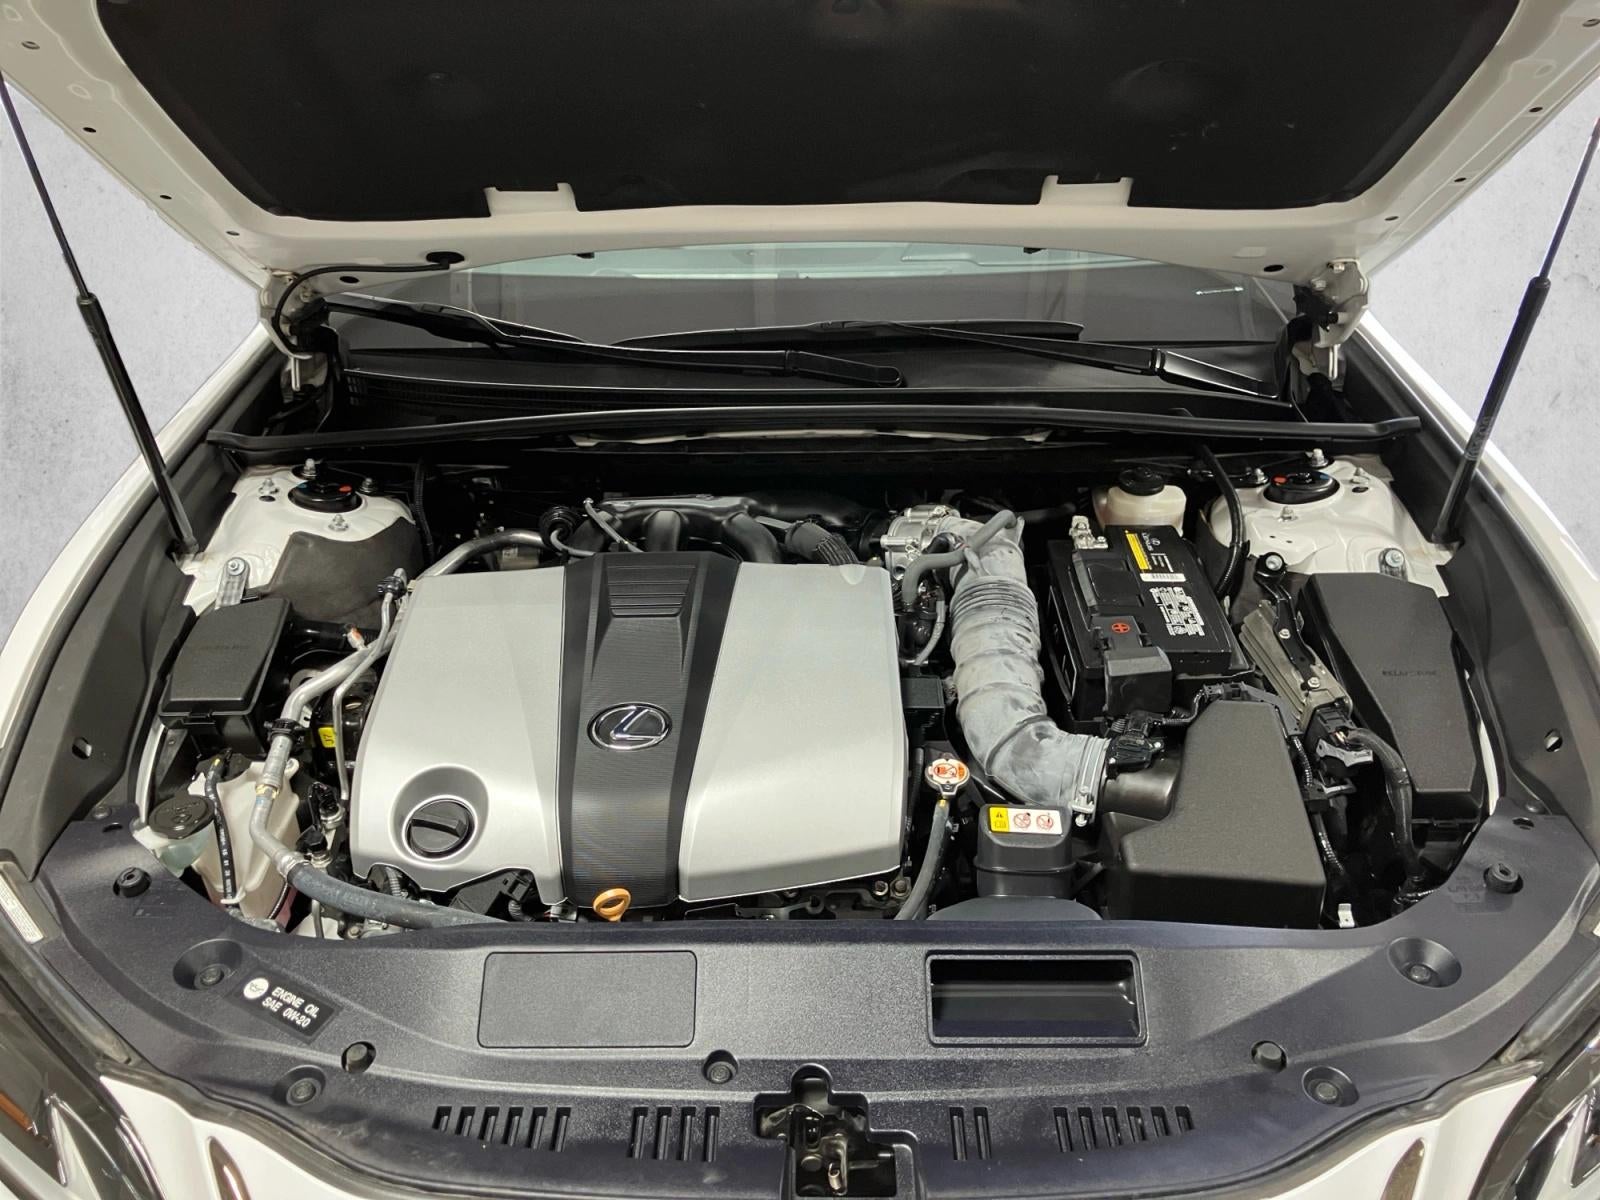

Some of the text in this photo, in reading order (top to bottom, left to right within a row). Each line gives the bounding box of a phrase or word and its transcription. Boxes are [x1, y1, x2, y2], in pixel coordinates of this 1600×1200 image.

[261, 996, 283, 1012] SAE
[271, 986, 320, 1019] ENGINE OIL
